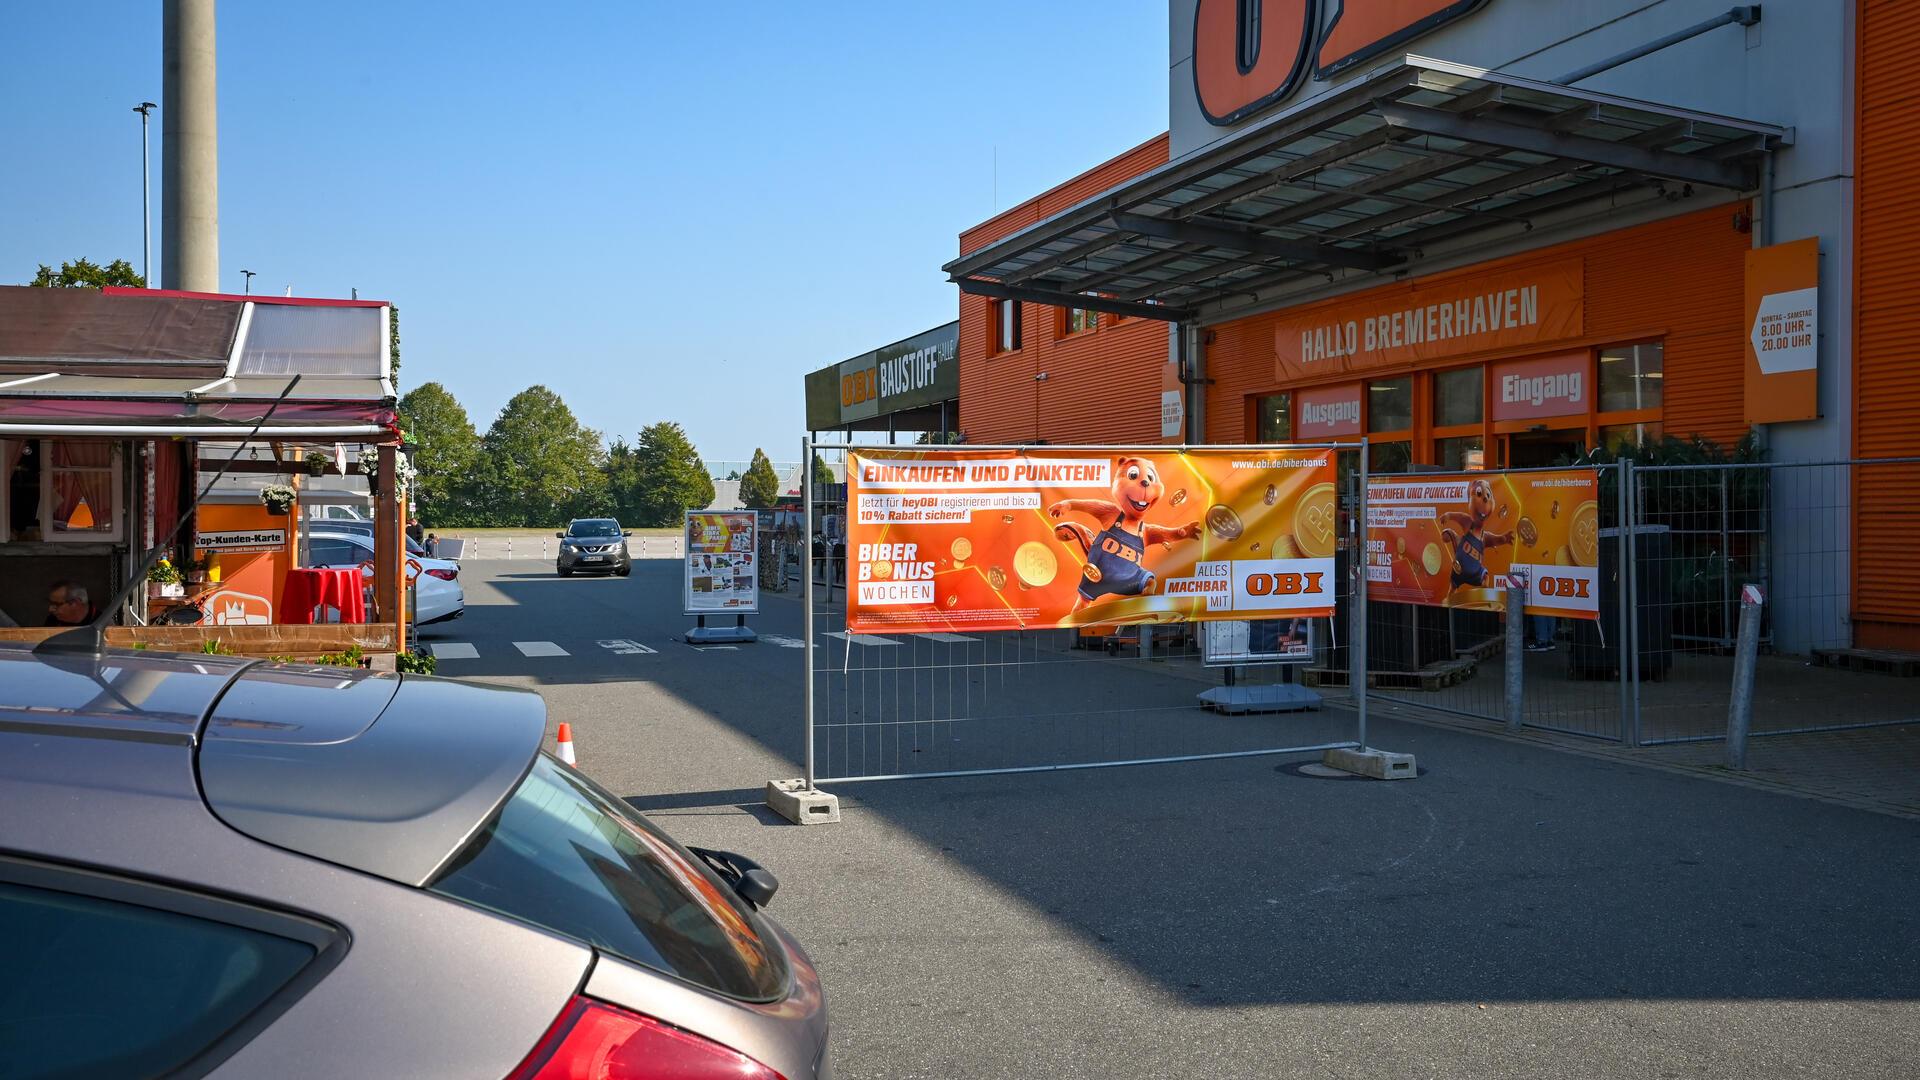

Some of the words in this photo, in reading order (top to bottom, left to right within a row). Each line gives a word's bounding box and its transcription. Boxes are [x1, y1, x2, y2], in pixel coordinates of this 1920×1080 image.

[1761, 314, 1782, 322] MONTAG
[1787, 310, 1812, 320] SAMSTAG
[1302, 321, 1357, 362] HALLO
[1365, 286, 1537, 352] BREMERHAVEN
[1761, 324, 1782, 337] 8.00
[1785, 320, 1804, 333] UHR
[1762, 337, 1788, 351] 20.00
[1792, 334, 1811, 348] UHR
[842, 368, 877, 408] OBI
[880, 344, 937, 398] BAUSTOFF
[1502, 372, 1582, 406] Eingang
[1302, 400, 1360, 426] Ausgang
[1232, 458, 1328, 469] www.obi.de/biberbonus
[863, 465, 966, 483] EINKAUFEN
[971, 464, 1009, 482] UND
[1532, 479, 1591, 487] www.obi.de/biberbonus
[1407, 488, 1422, 498] UND
[861, 496, 882, 508] Jetzt
[886, 496, 898, 507] für
[902, 496, 938, 510] heyOBI
[941, 496, 991, 510] registrieren
[993, 496, 1010, 507] und
[1013, 496, 1025, 506] bis
[1028, 498, 1038, 506] zu
[888, 510, 922, 521] Rabatt
[858, 544, 917, 561] BIBER
[1198, 565, 1228, 576] ALLES
[1168, 580, 1228, 593] MACHBAR
[1246, 572, 1324, 596] OBI
[1539, 576, 1590, 598] OBI
[863, 586, 930, 600] WOCHEN
[1210, 596, 1228, 607] MIT
